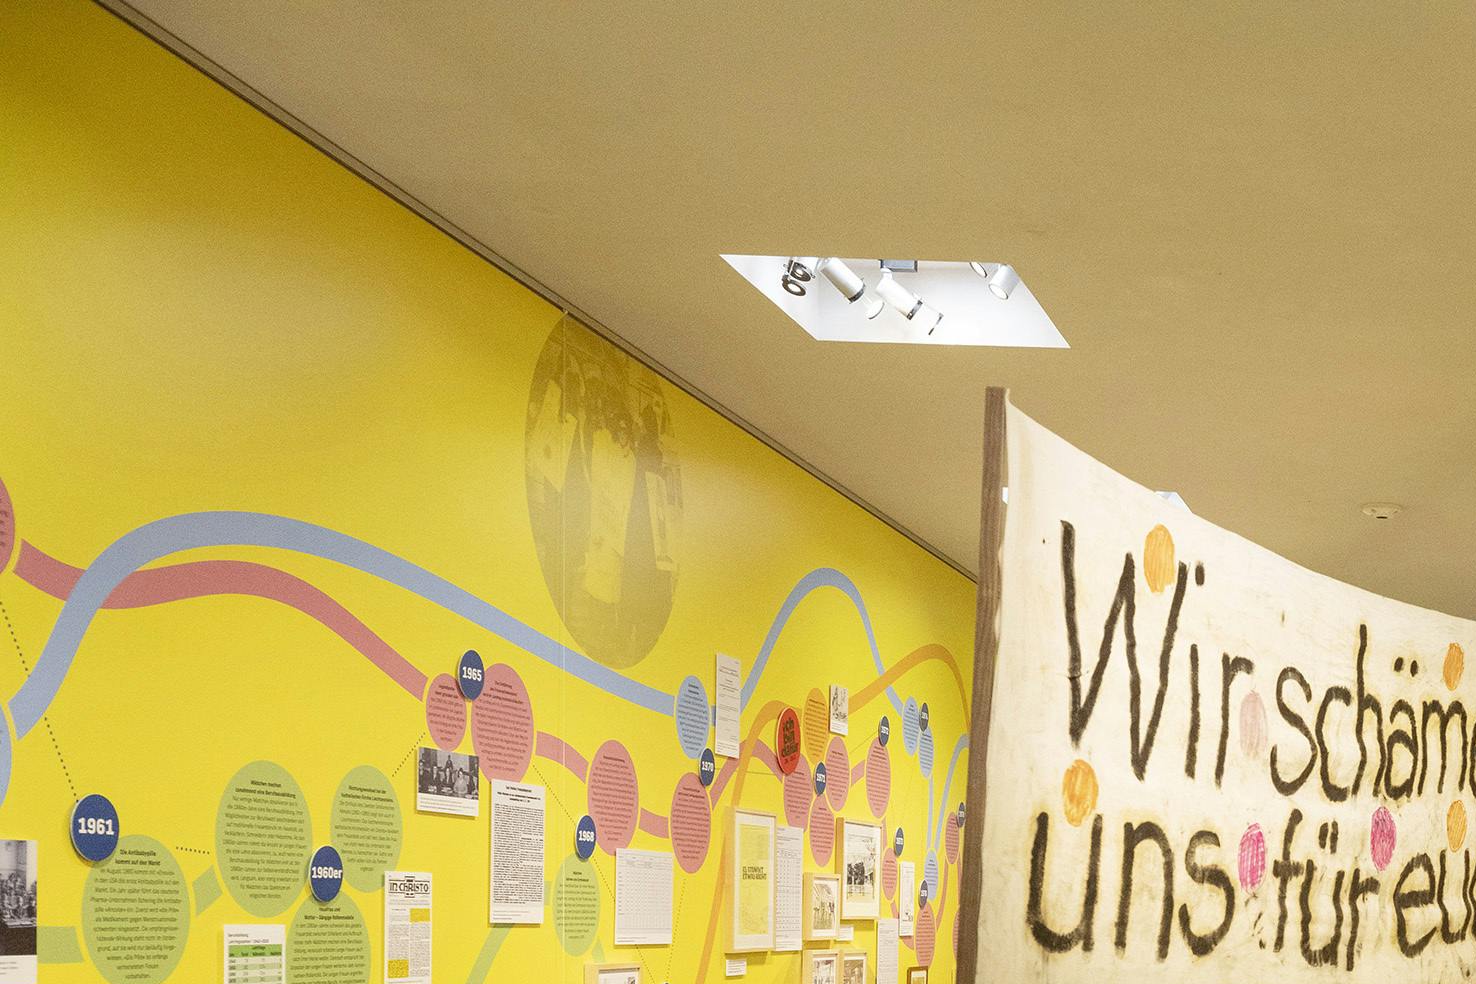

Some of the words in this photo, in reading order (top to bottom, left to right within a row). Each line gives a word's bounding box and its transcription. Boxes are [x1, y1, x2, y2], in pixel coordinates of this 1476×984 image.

[1061, 520, 1254, 788] Wir
[462, 667, 482, 682] 1965
[78, 817, 115, 836] 1961
[578, 830, 595, 842] 1968
[312, 866, 343, 880] 1960er
[398, 882, 429, 892] CHRISTO
[1272, 809, 1380, 971] für
